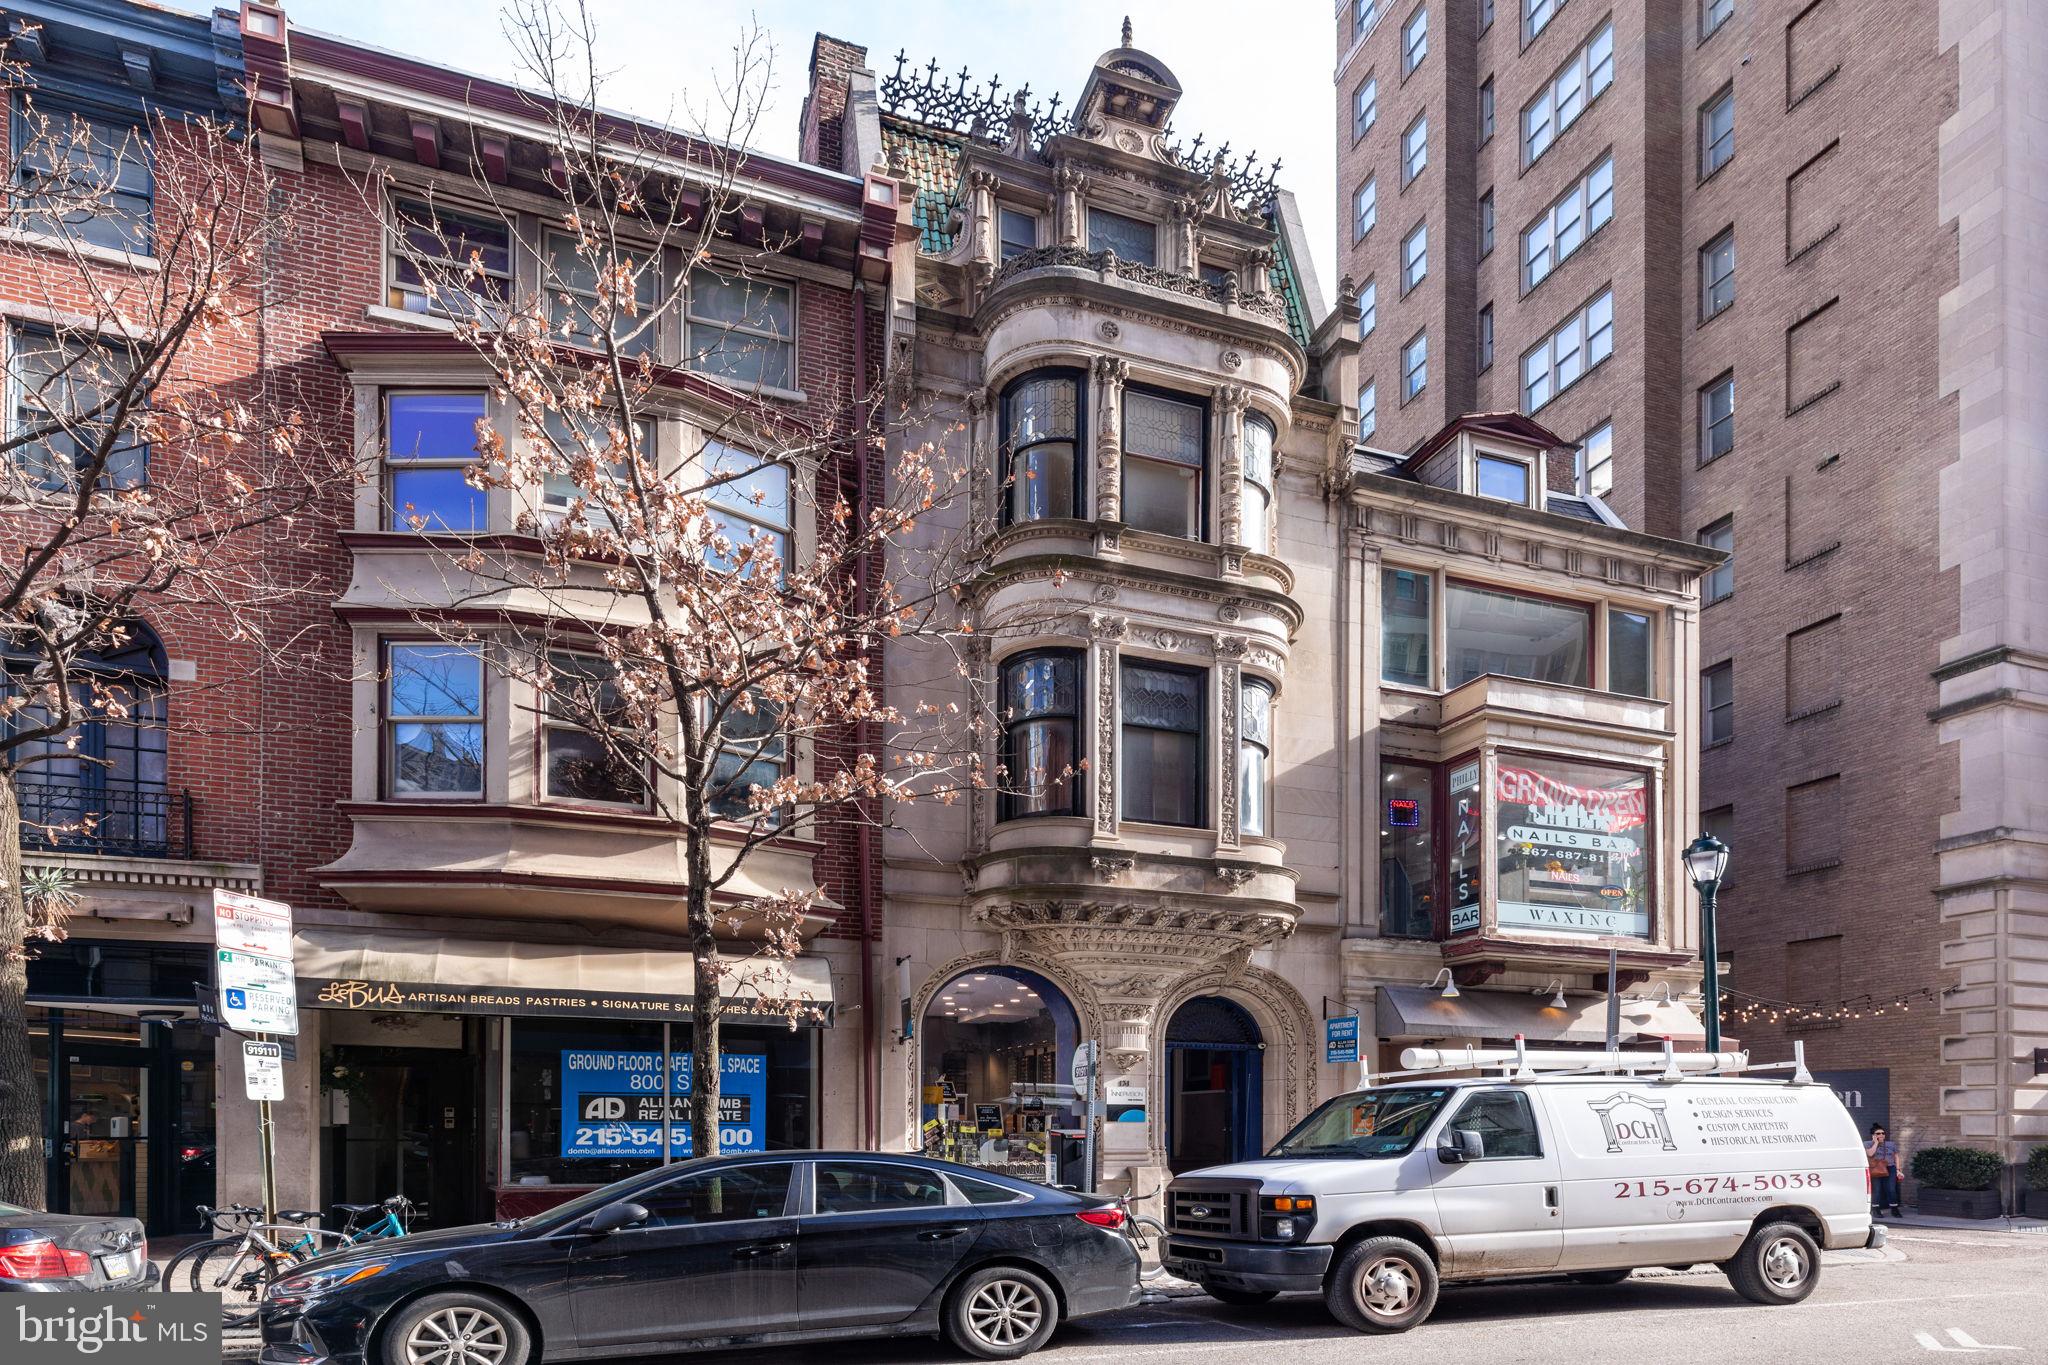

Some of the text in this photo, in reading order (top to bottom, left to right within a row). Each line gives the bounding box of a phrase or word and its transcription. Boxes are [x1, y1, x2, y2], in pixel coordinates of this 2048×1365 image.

[1452, 768, 1479, 788] PHILLY
[1501, 770, 1581, 807] GRAND
[1512, 828, 1577, 845] NAILS
[1458, 797, 1470, 900] NAILS
[1551, 870, 1580, 882] NAILS
[1600, 889, 1624, 897] OPEN
[219, 907, 274, 927] NO STOPPING
[1452, 909, 1479, 926] BAR
[223, 953, 284, 969] 2 HR PARKING
[249, 992, 292, 1006] RESERVED
[408, 992, 466, 1004] ARTISAN
[470, 995, 520, 1005] BREADS
[526, 997, 586, 1007] PASTRIES
[602, 1000, 670, 1011] SIGNATURE
[674, 1003, 748, 1015] SACHES
[750, 1006, 759, 1015] &
[252, 1002, 290, 1015] PARKING
[1331, 1030, 1341, 1038] FOR
[247, 1045, 278, 1056] 919111
[568, 1054, 615, 1071] GROUND
[617, 1055, 652, 1072] FLOOR
[727, 1058, 760, 1074] SPACE
[630, 1074, 665, 1090] 800
[585, 1097, 626, 1119] AD
[1696, 1095, 1799, 1106] GENERAL CONSTRUCTION
[638, 1109, 684, 1121] REAL
[1701, 1108, 1774, 1119] DESIGN SERVICES
[1615, 1120, 1659, 1140] DCH
[1706, 1121, 1789, 1132] CUSTOM CARPENTRY
[575, 1127, 753, 1146] 215-545-00
[1710, 1133, 1818, 1146] HISTORICAL RESTORATION
[567, 1147, 655, 1155] domb@allandomb.com
[1614, 1173, 1823, 1199] 215-674-5038
[1675, 1194, 1774, 1207] www.DCHContractors.com
